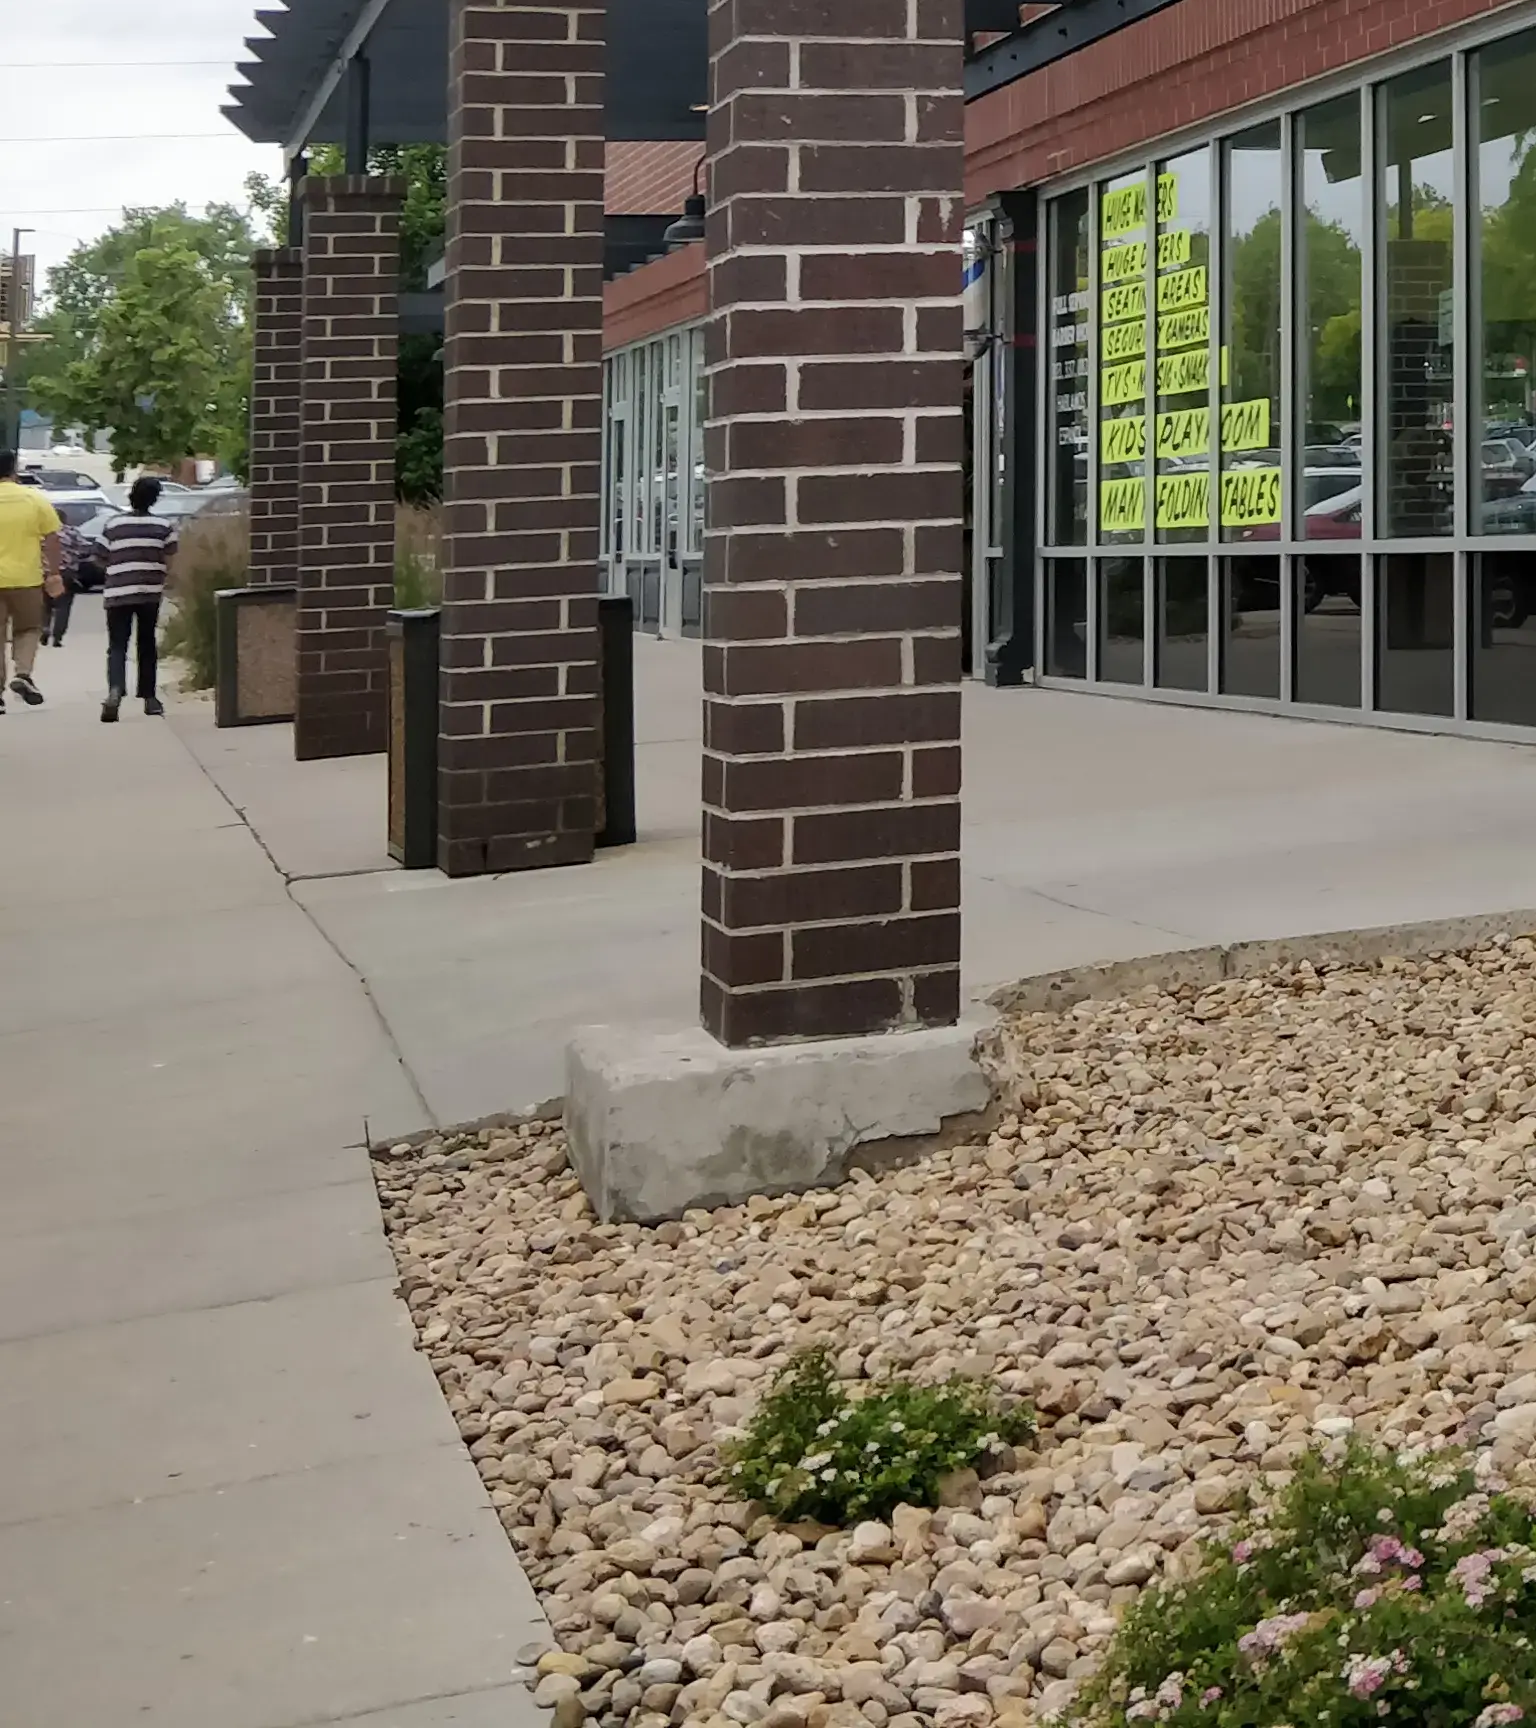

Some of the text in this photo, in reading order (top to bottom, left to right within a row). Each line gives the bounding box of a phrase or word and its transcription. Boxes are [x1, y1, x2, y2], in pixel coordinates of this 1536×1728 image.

[1106, 244, 1138, 278] HUGE
[1161, 269, 1201, 305] AREAS
[1106, 421, 1146, 460] KIDS
[1156, 476, 1210, 522] FOLDIN
[1222, 473, 1280, 520] TABLES
